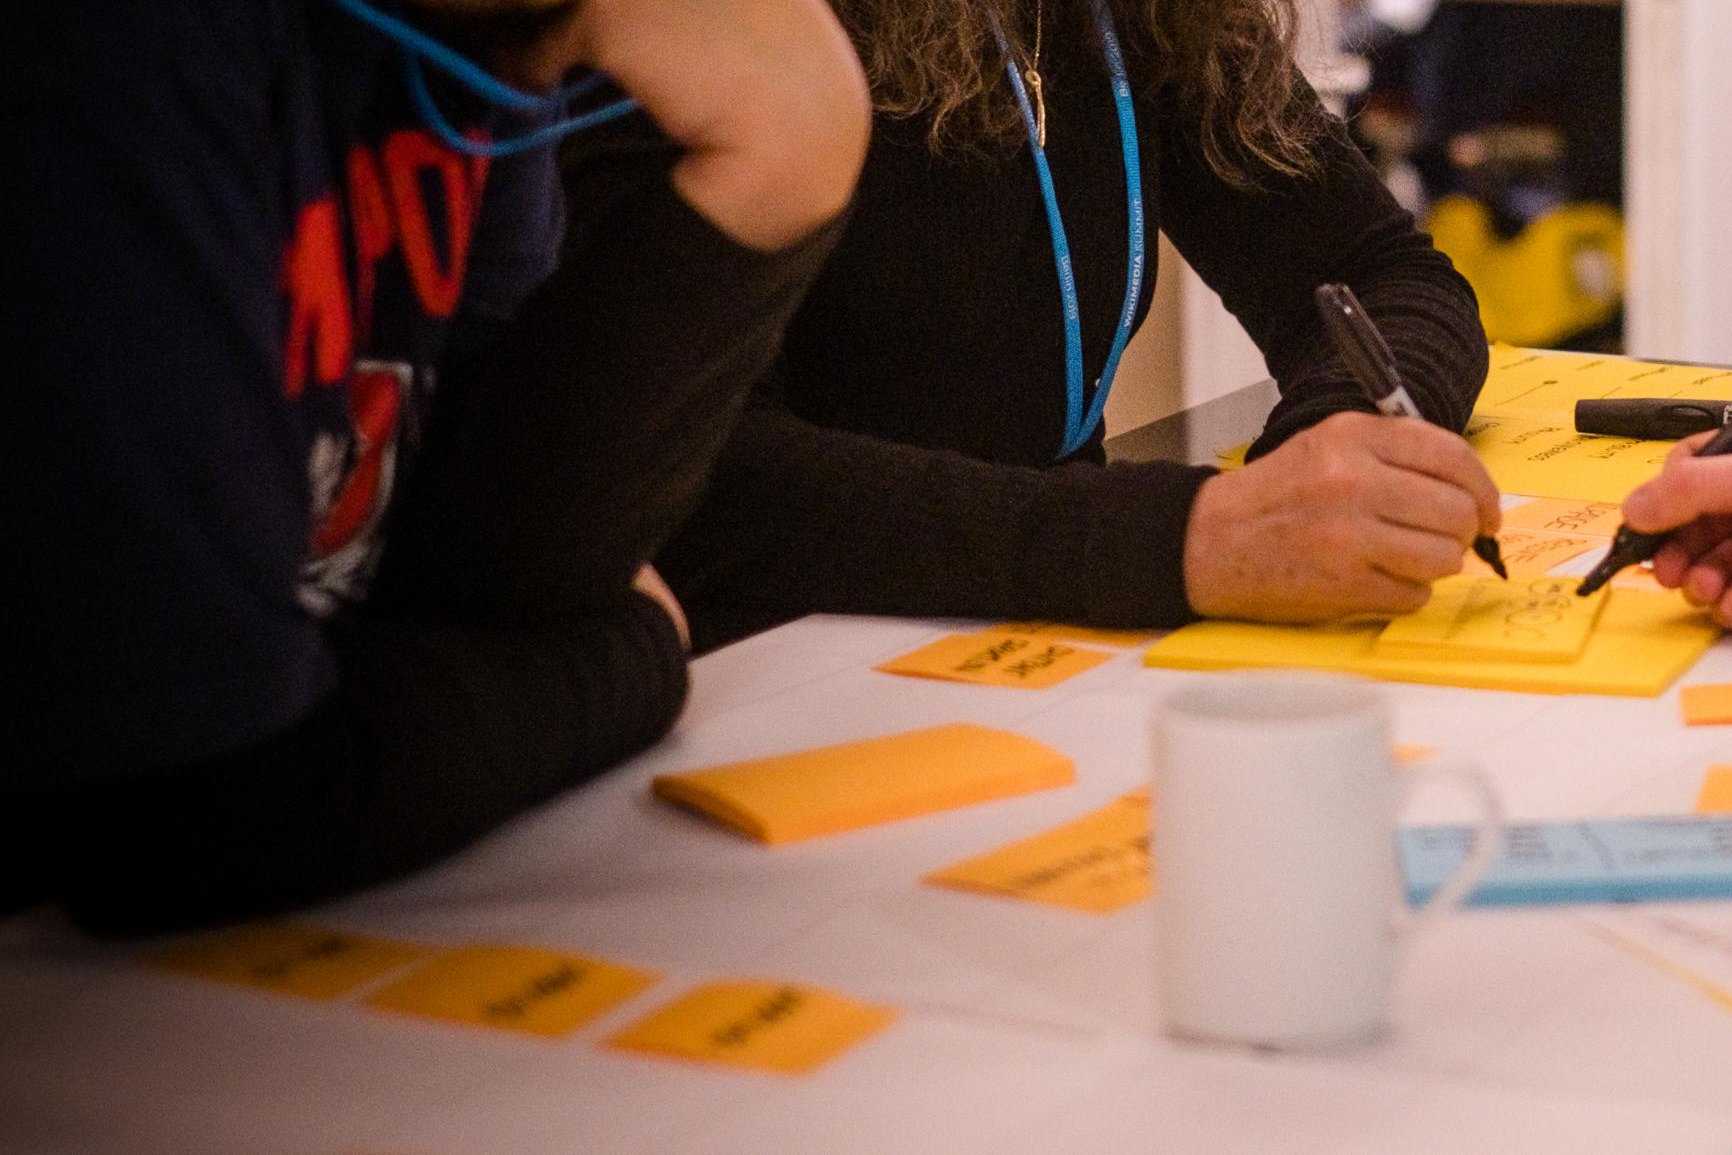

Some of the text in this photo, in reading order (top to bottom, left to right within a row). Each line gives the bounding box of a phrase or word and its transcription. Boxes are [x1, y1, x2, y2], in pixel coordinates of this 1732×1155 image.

[1061, 256, 1077, 320] Berlin 2019
[1124, 198, 1143, 328] WIKIMEDIA SUMMIT
